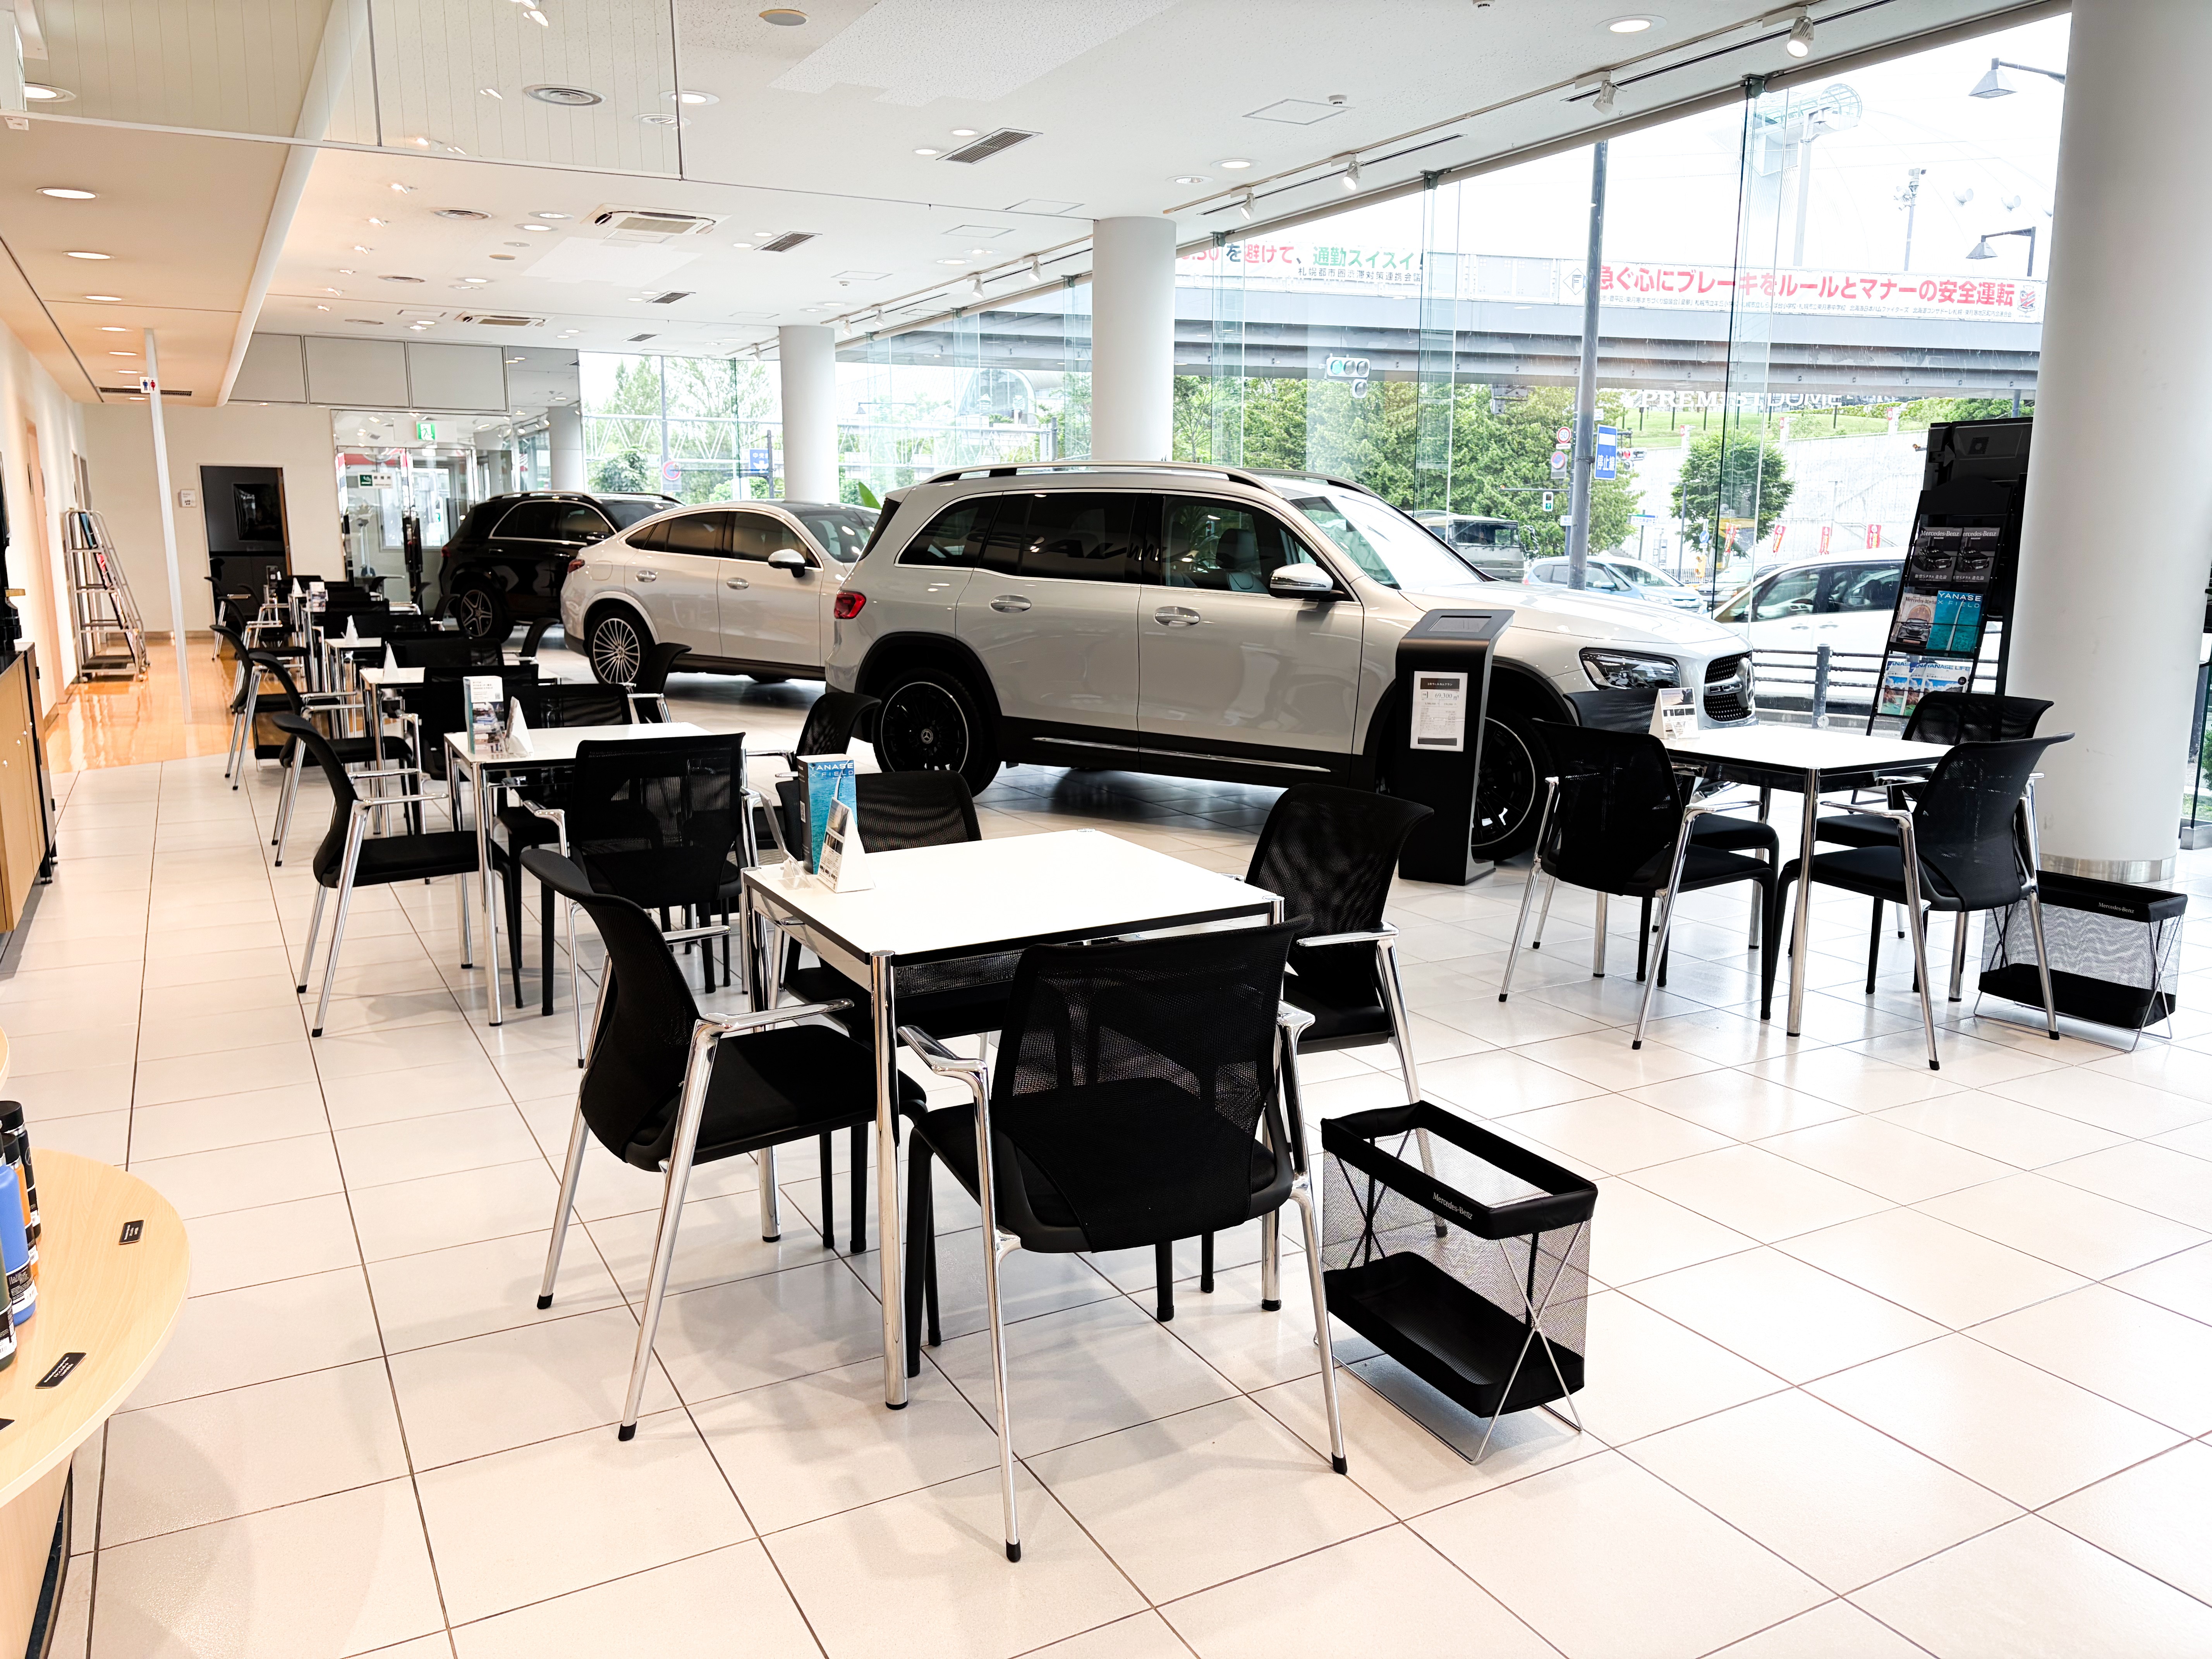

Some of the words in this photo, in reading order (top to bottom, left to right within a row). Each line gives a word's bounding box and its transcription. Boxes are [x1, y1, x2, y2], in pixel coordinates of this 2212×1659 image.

[1298, 267, 1421, 282] 札幌都市圏渋滞対策連携会議
[1939, 592, 1982, 602] YANASE
[809, 763, 854, 771] YANASE
[2098, 902, 2135, 914] Mercedes-Benz
[1433, 1192, 1473, 1220] Mercedes-Benz
